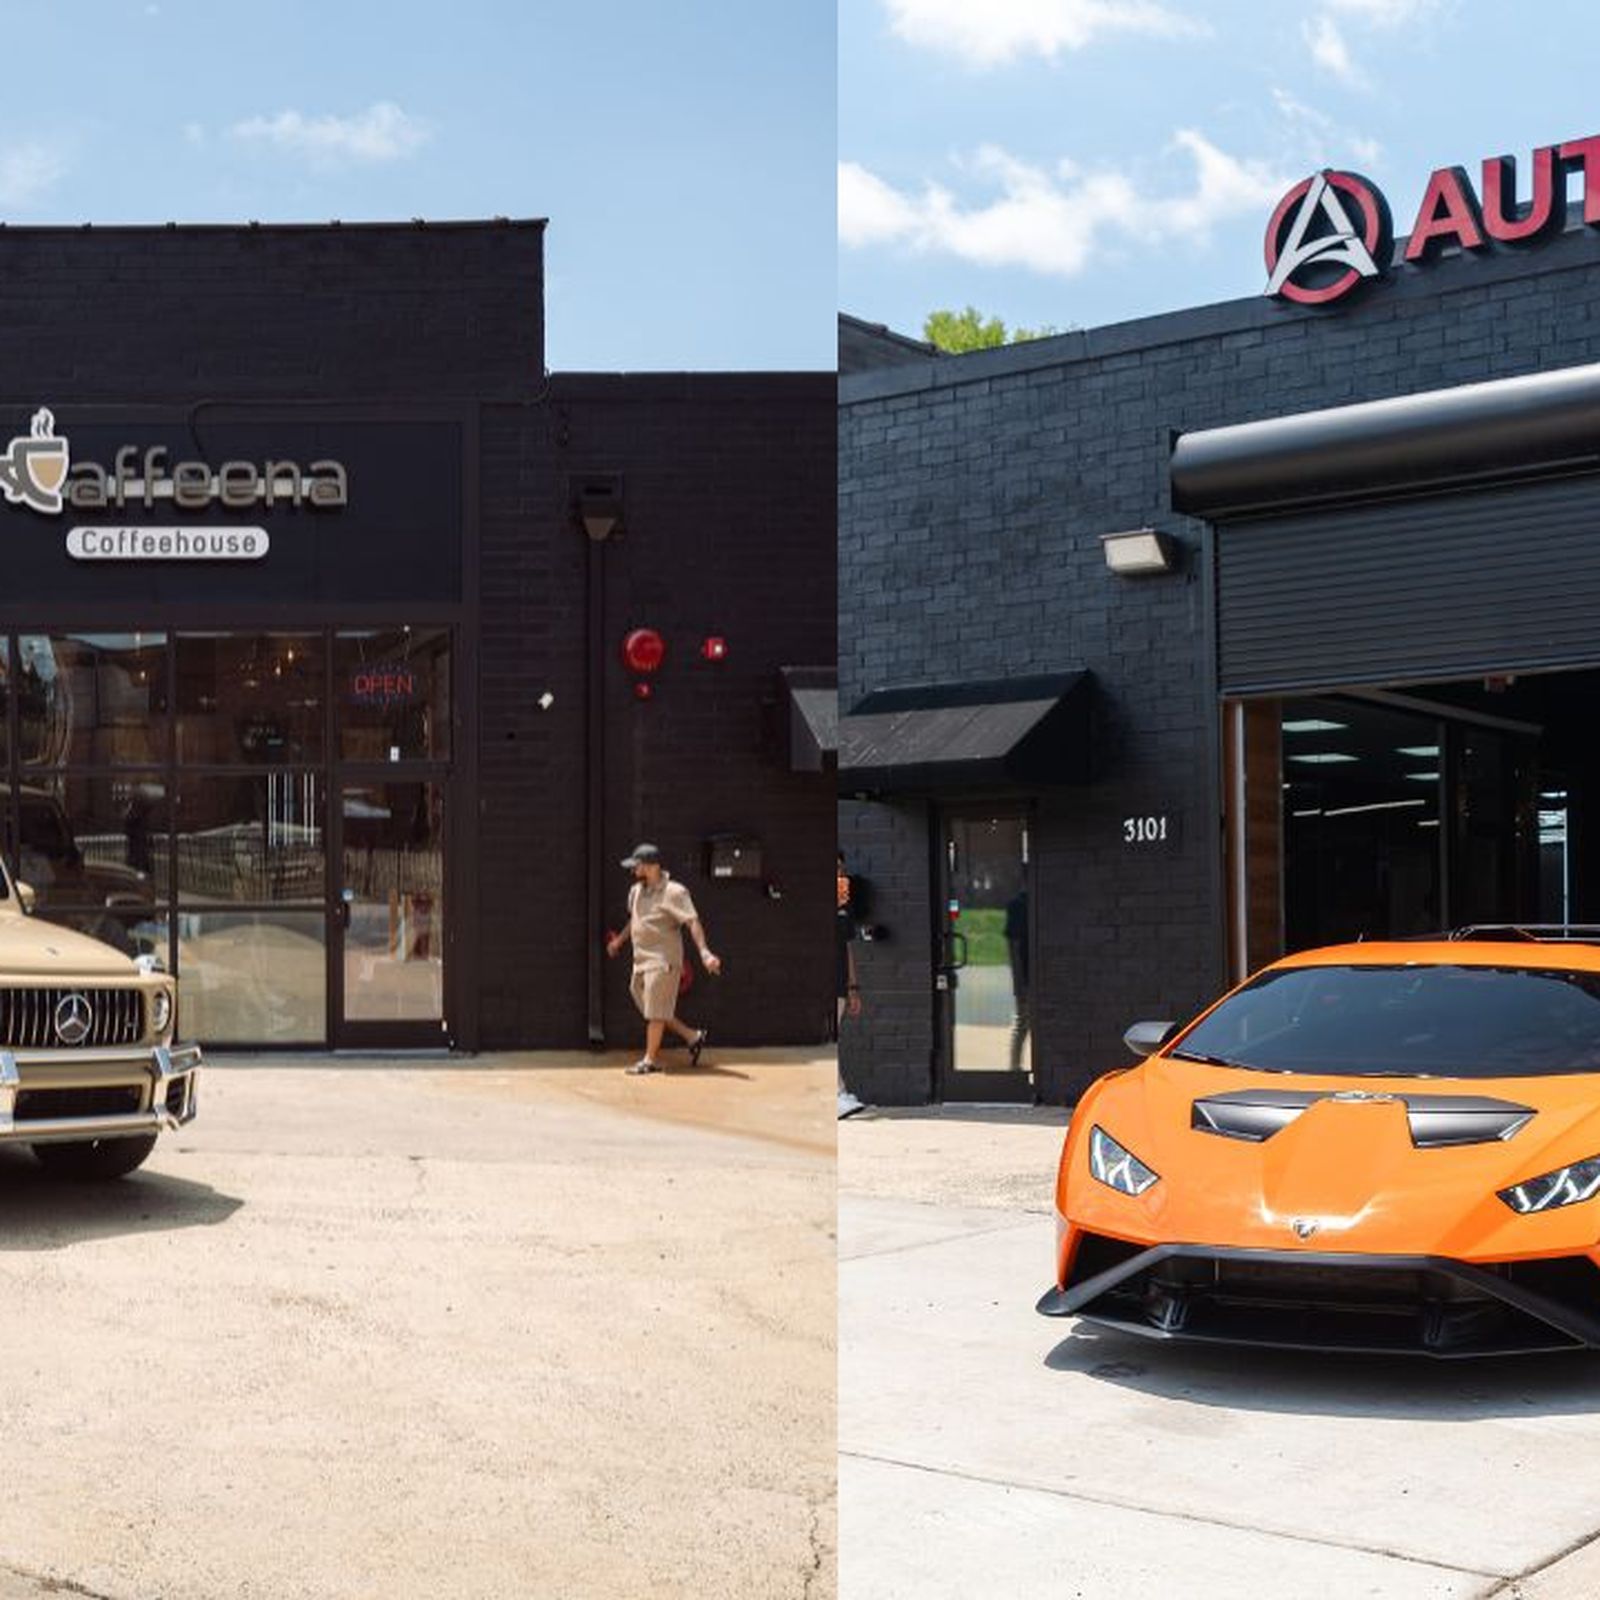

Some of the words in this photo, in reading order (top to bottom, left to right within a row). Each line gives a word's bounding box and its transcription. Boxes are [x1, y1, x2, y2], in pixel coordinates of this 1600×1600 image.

[80, 529, 258, 555] Coffeehouse
[354, 673, 413, 695] OPEN
[1123, 816, 1167, 842] 3101
